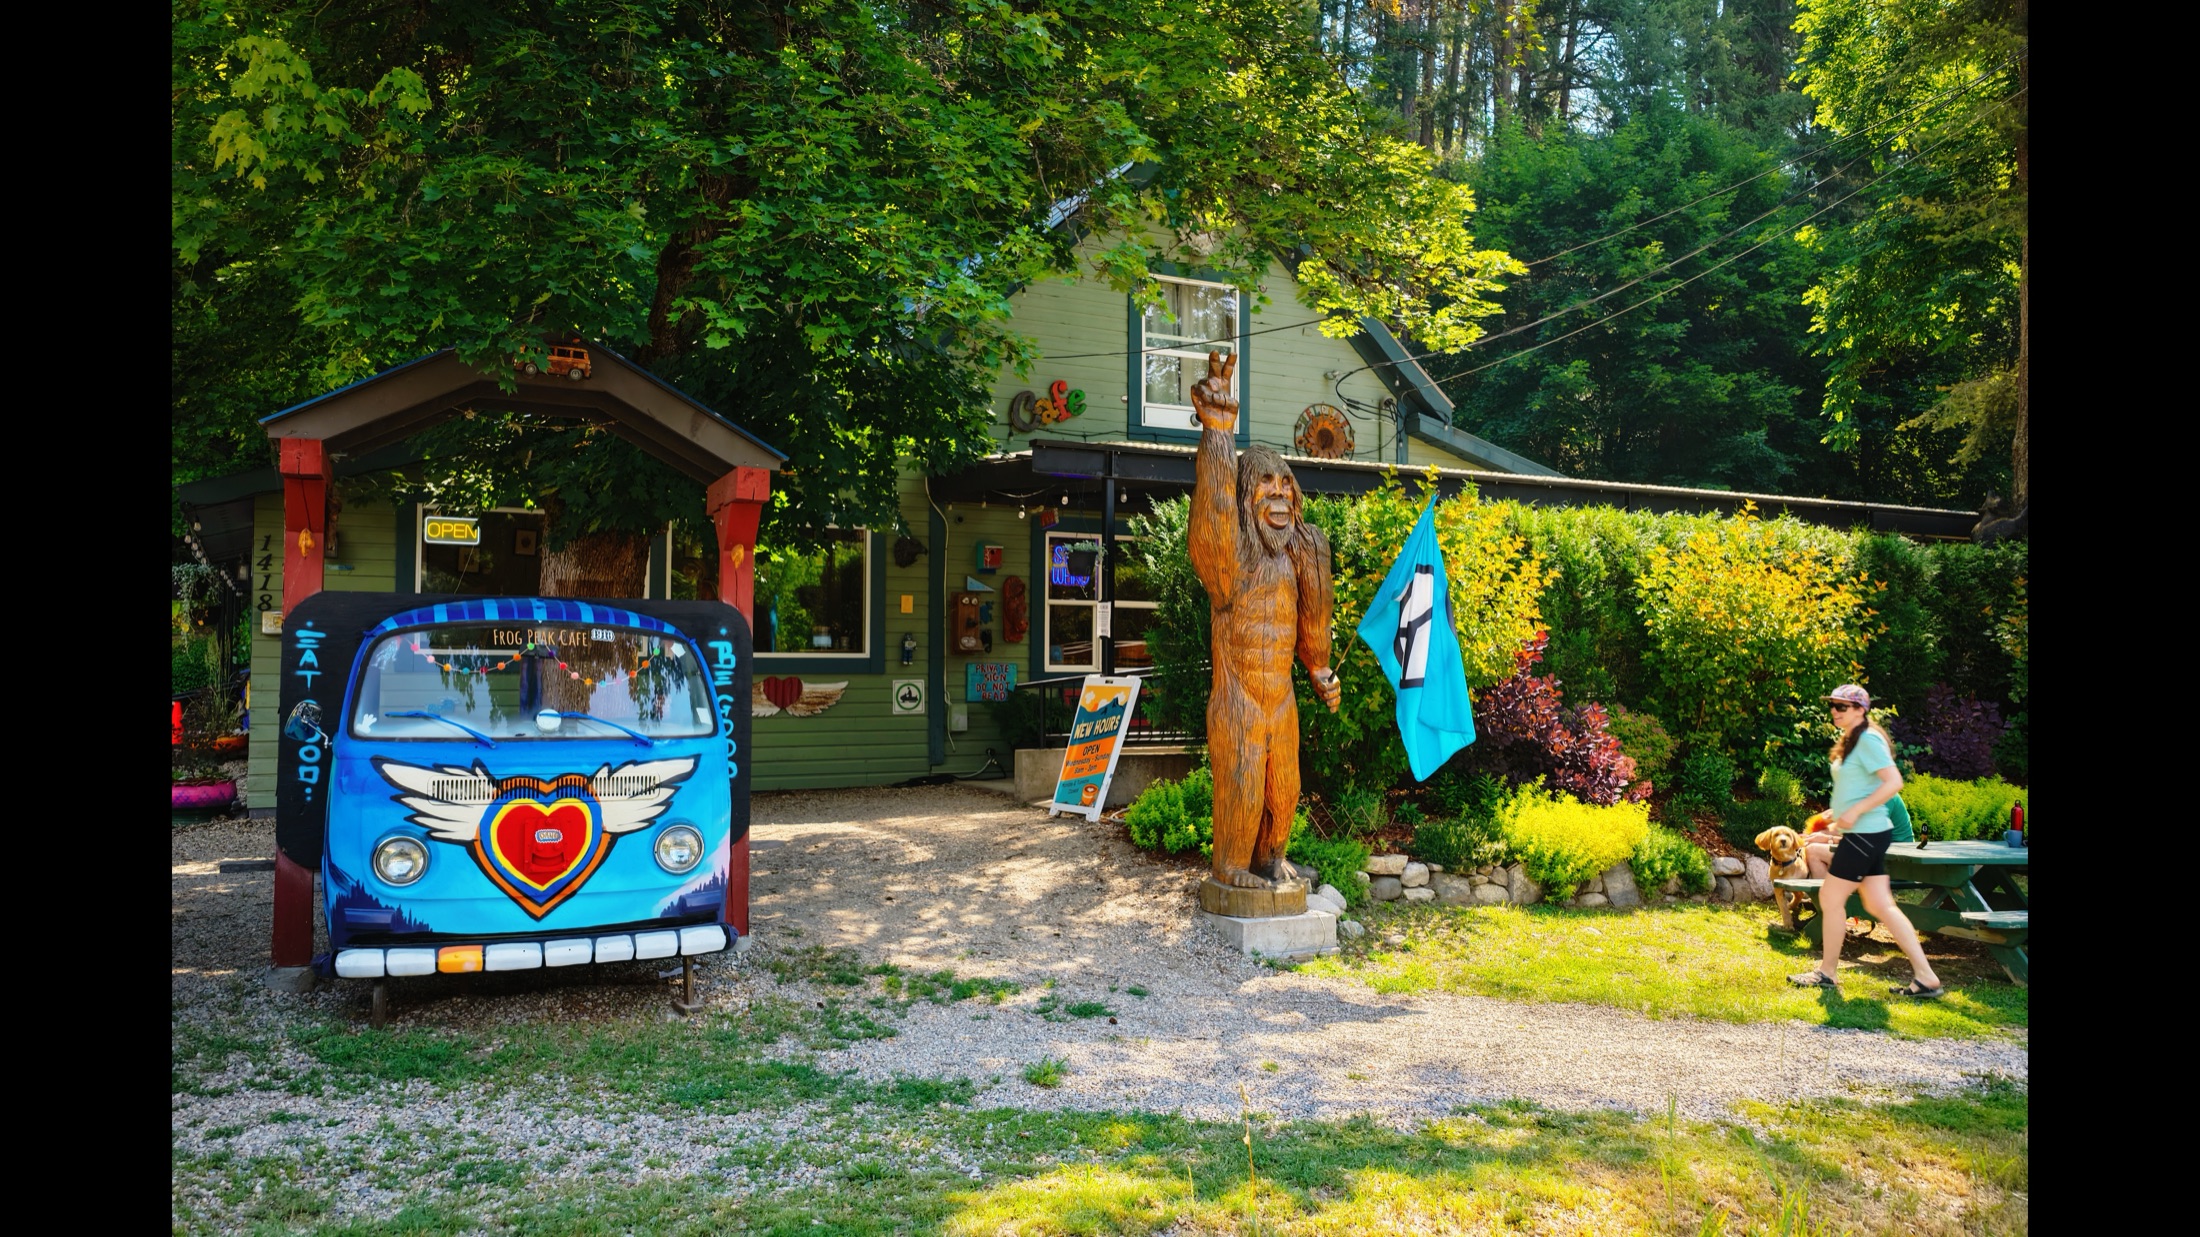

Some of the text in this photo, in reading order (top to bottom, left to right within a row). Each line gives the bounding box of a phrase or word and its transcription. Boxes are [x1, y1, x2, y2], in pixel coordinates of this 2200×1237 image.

[1008, 379, 1087, 432] Cafe
[427, 522, 478, 539] OPEN
[256, 534, 273, 611] 1418
[493, 628, 588, 647] FROG PEAK CAFE
[295, 629, 327, 691] EAT
[708, 641, 737, 686] BE
[976, 664, 1009, 674] PRIVATE
[976, 681, 1011, 692] DO NOT
[984, 673, 1006, 682] SIGN
[981, 691, 1006, 701] READ
[1073, 715, 1121, 740] NEW HOURS
[1082, 744, 1101, 756] OPEN
